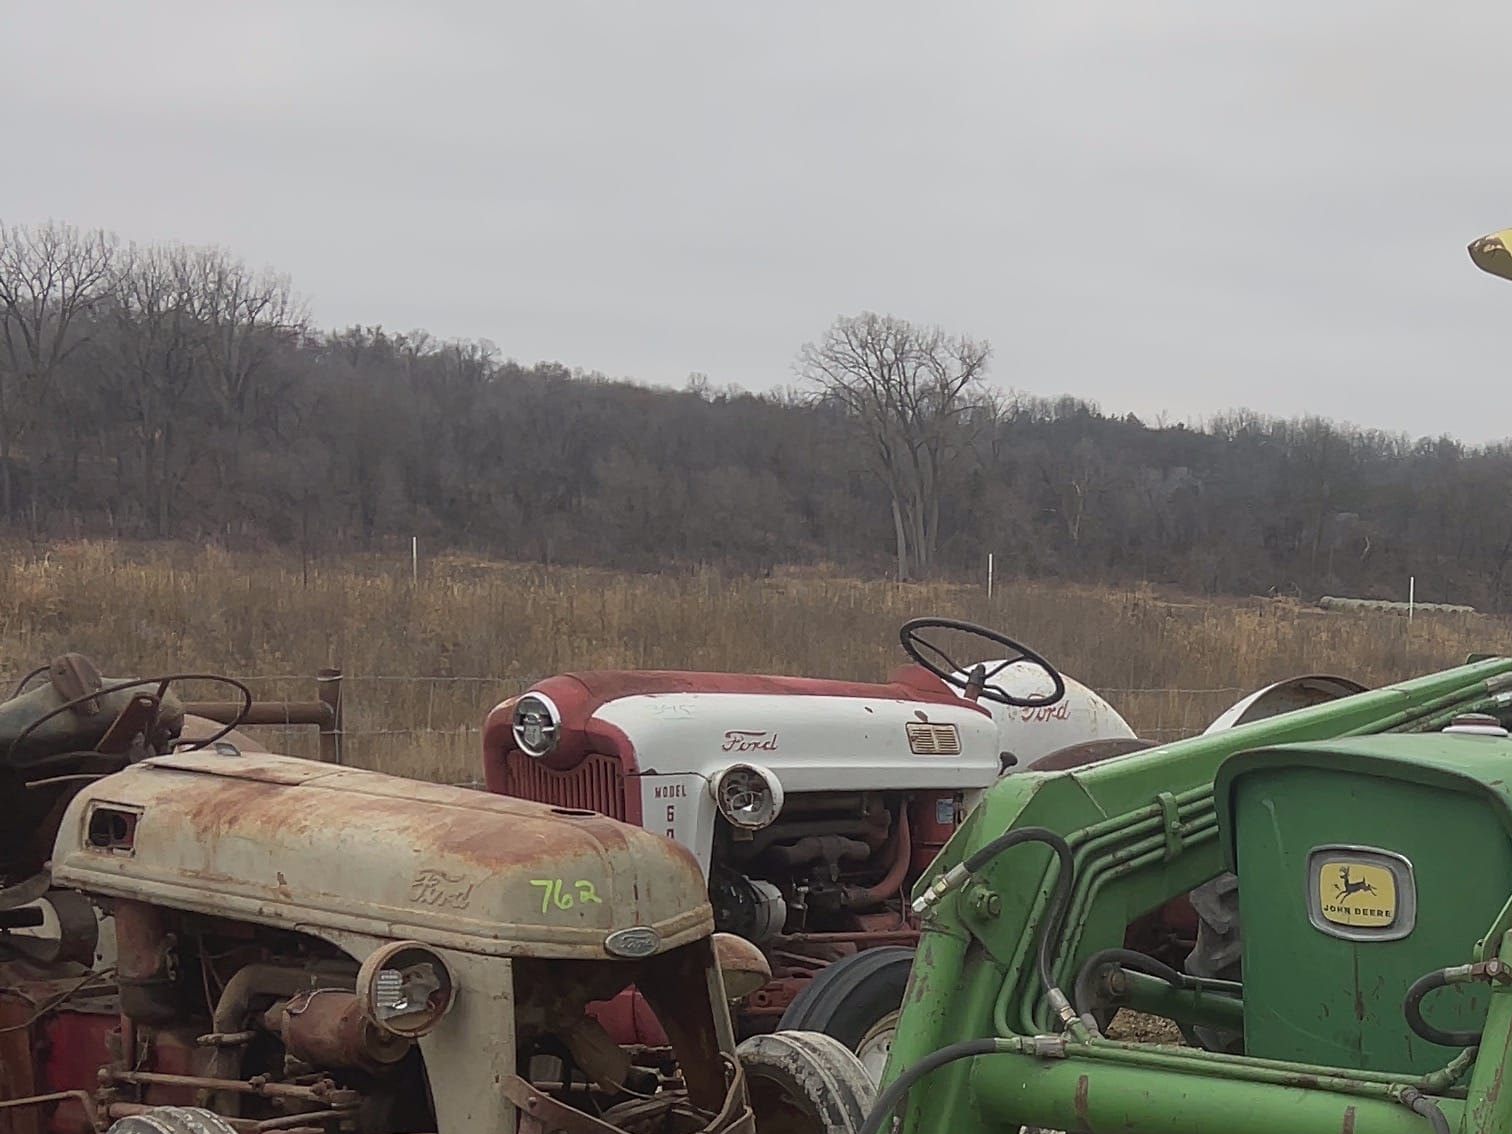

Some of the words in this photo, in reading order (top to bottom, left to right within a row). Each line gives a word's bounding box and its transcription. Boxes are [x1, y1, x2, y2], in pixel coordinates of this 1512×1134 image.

[721, 730, 778, 751] Ford
[654, 784, 687, 799] MODEL
[409, 868, 475, 909] Ford
[529, 879, 603, 913] 762
[1323, 904, 1351, 915] JOHN
[1354, 907, 1392, 918] DEERE
